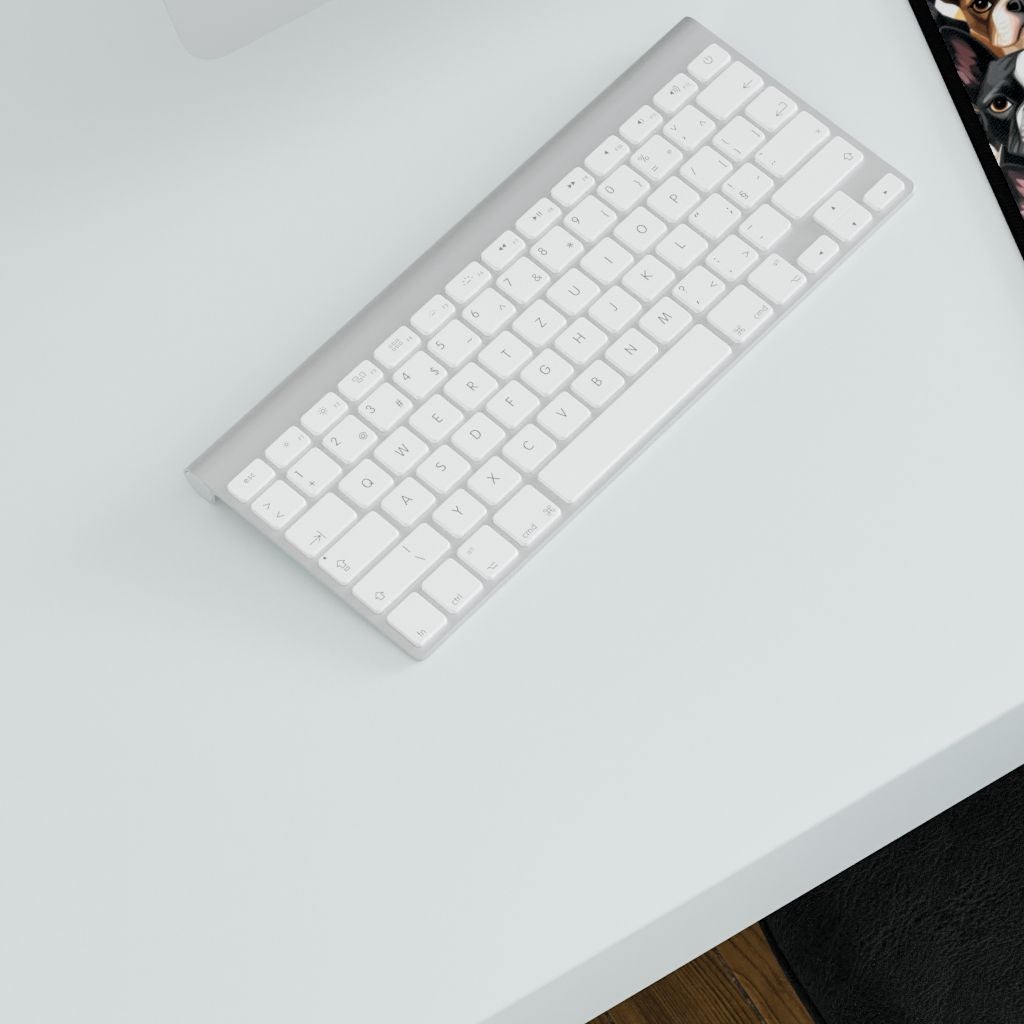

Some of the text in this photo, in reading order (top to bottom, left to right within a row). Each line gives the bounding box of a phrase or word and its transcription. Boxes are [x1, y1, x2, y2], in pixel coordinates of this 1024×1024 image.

[668, 193, 678, 204] P
[571, 216, 580, 224] 9
[636, 224, 648, 234] O
[537, 247, 548, 256] 8
[640, 270, 653, 280] K
[503, 278, 512, 287] 7
[567, 285, 581, 296] U
[609, 302, 618, 312] J
[470, 310, 480, 318] 6
[657, 312, 672, 325] M
[534, 317, 547, 328] Z
[572, 332, 586, 344] H
[435, 341, 445, 350] 5
[624, 344, 638, 356] N
[500, 348, 511, 358] T
[539, 364, 551, 375] G
[402, 372, 411, 381] 4
[590, 376, 602, 387] B
[466, 381, 478, 391] R
[504, 396, 514, 407] F
[365, 405, 376, 414] 3
[556, 408, 567, 417] V
[431, 413, 444, 424] E
[469, 429, 482, 440] D
[330, 436, 341, 446] 2
[521, 440, 534, 451] C
[394, 443, 409, 457] W
[435, 462, 447, 472] S
[294, 470, 304, 478] 1
[487, 472, 500, 486] X
[361, 478, 374, 488] Q
[401, 495, 414, 506] A
[451, 505, 463, 515] Y
